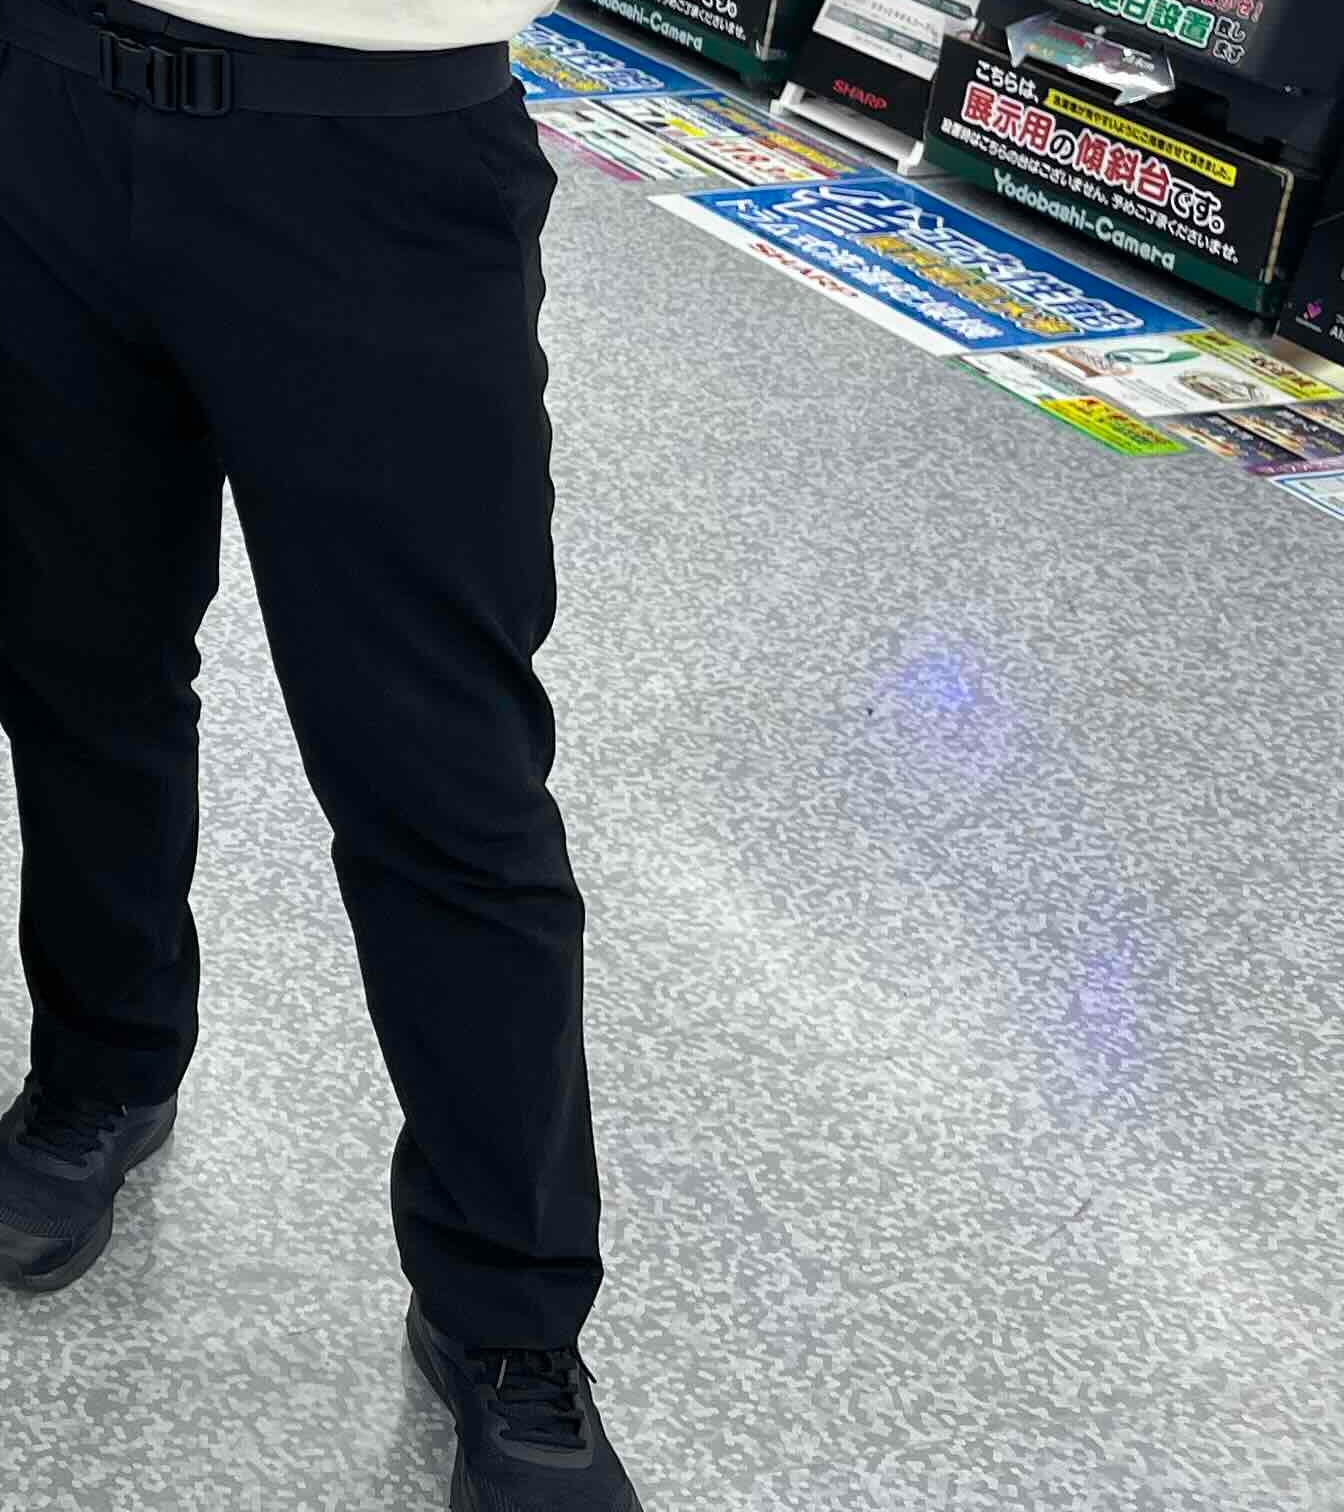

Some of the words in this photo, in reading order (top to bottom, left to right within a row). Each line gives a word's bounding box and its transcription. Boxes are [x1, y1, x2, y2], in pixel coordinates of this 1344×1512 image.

[833, 80, 888, 109] SHARP
[963, 81, 1225, 235] 展示用の傾斜台です。
[993, 168, 1175, 270] Yodobashi-Camera
